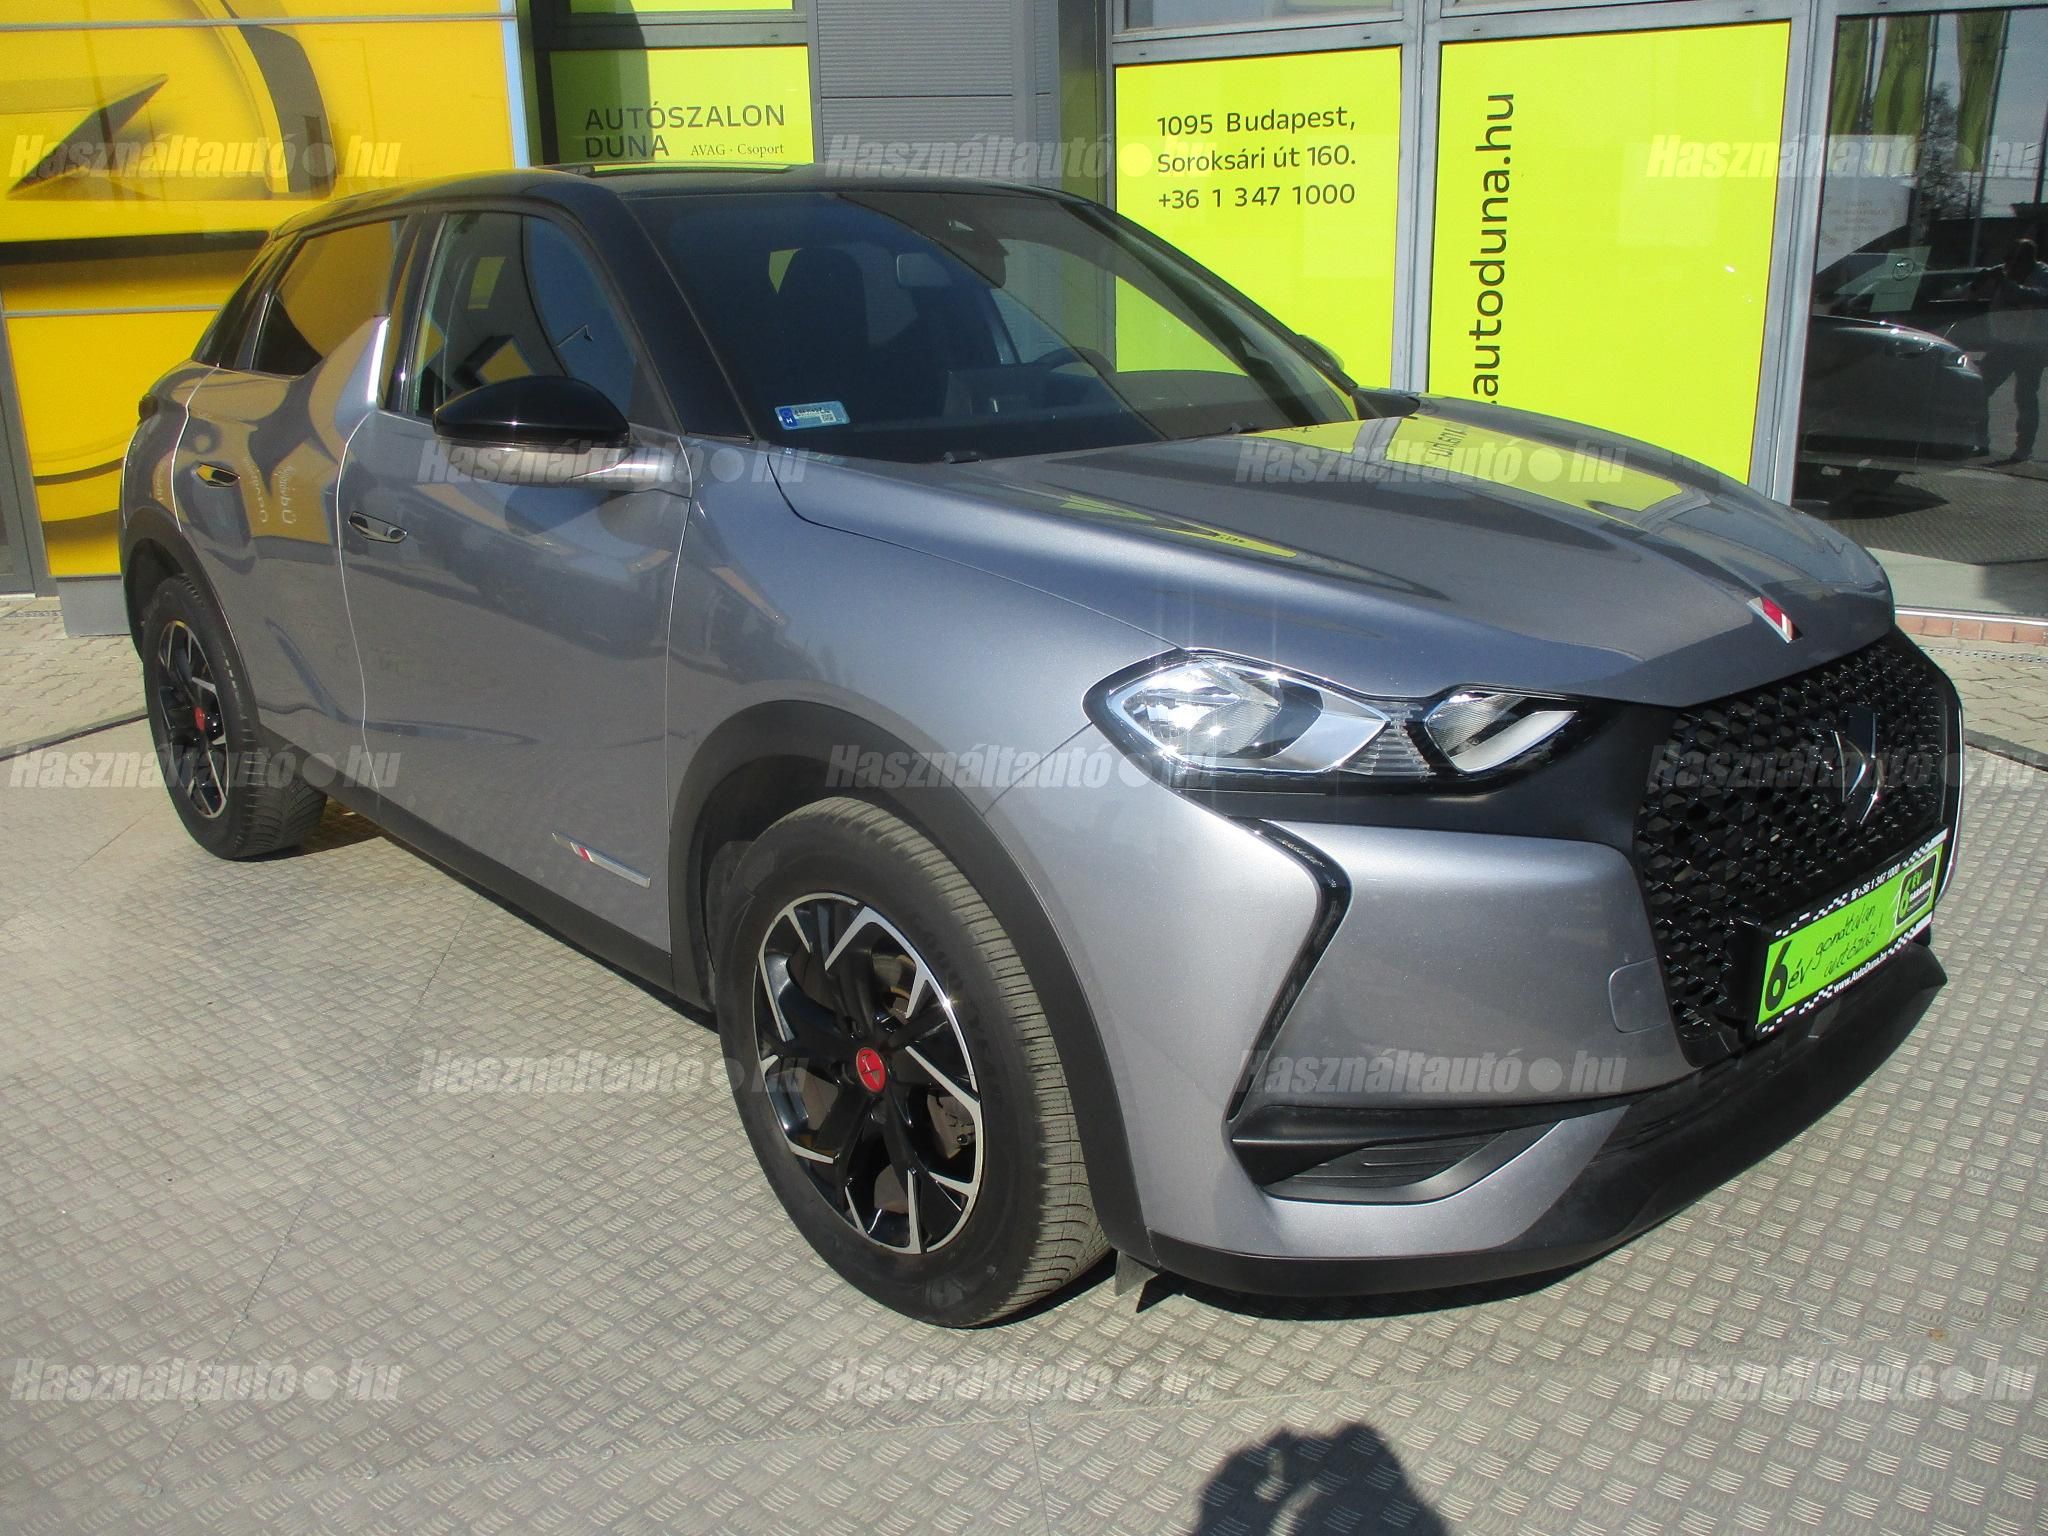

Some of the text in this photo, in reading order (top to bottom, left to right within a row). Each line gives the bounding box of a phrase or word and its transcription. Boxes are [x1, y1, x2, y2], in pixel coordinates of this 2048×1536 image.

[585, 101, 785, 130] AUTÓSZALON
[1157, 106, 1355, 136] 1095 Budapest,
[585, 135, 784, 159] DUNA AVAG Csoport
[1157, 145, 1356, 173] Soroksári út 160.
[1158, 183, 1356, 209] +36 1 347 1000
[1765, 939, 1793, 1011] 6
[1787, 957, 1813, 989] év
